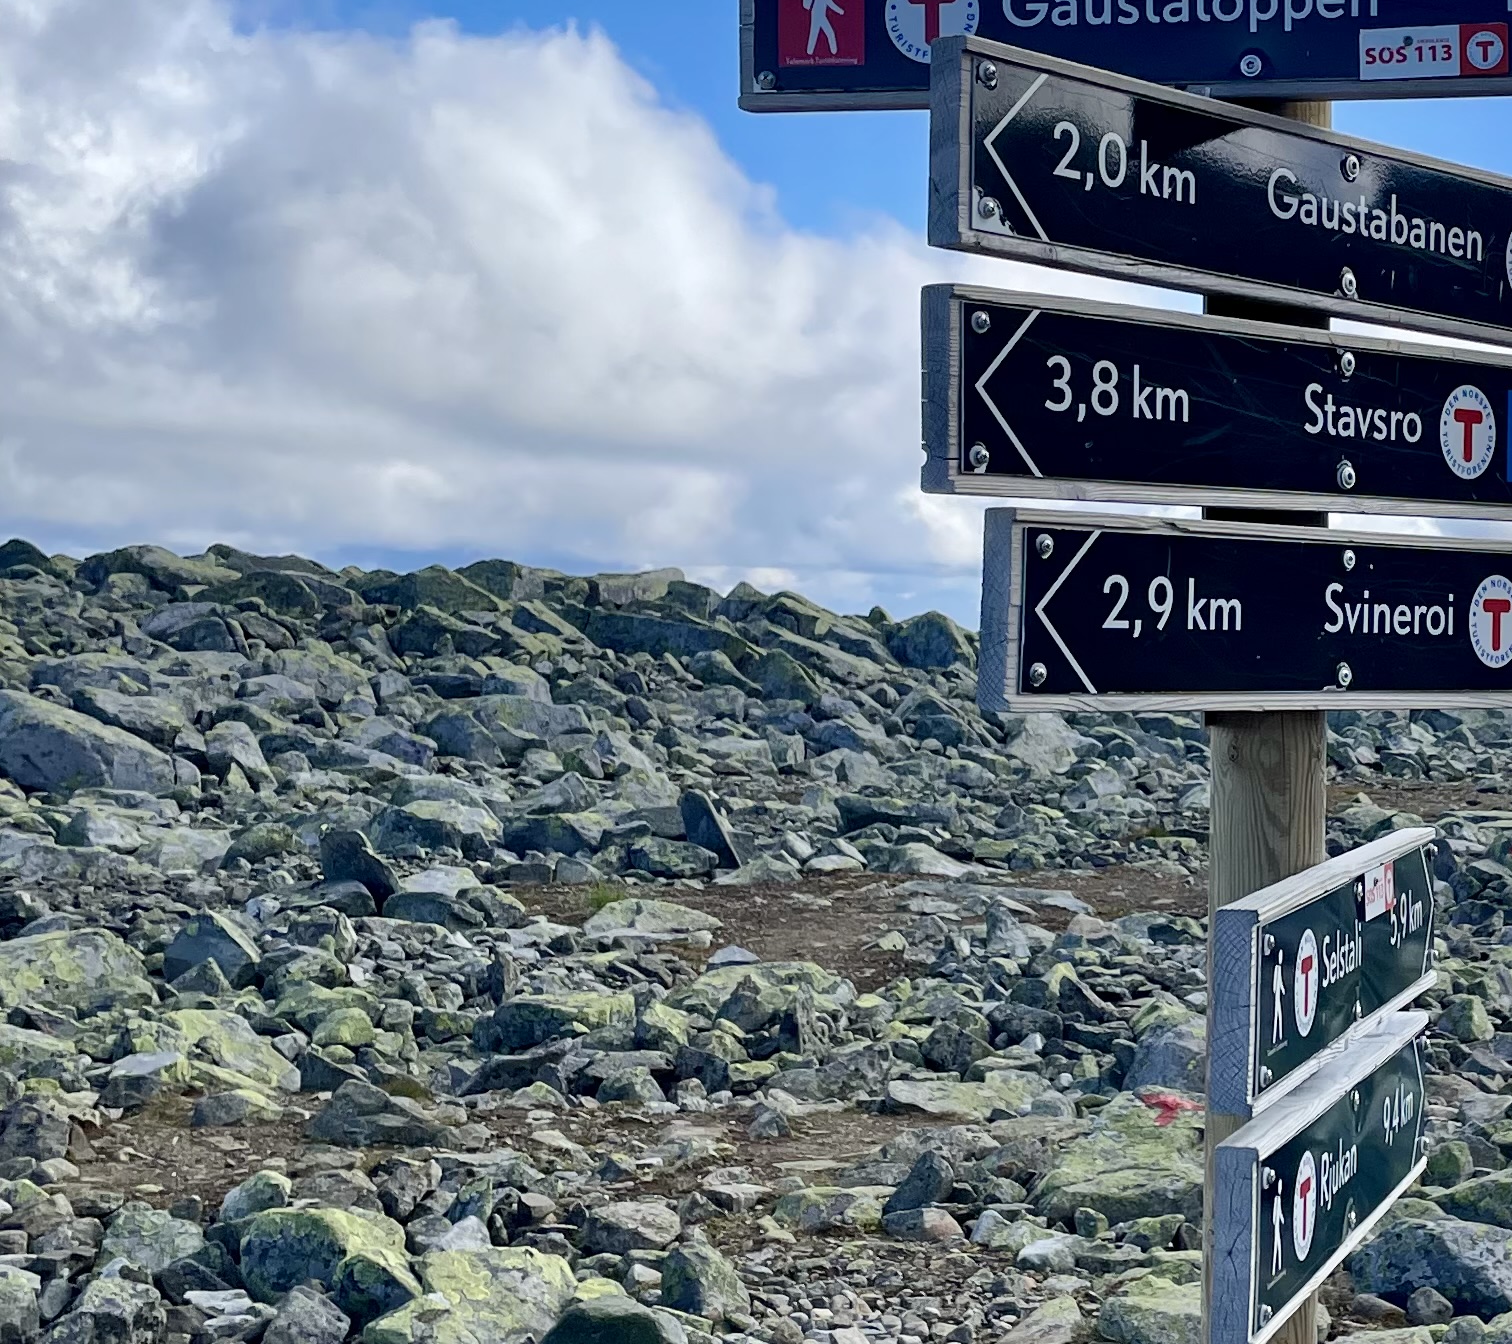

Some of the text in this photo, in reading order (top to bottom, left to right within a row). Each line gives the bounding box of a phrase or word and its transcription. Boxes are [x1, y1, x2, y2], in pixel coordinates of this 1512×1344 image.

[1365, 45, 1408, 65] SOS
[1414, 44, 1453, 63] 113
[1052, 120, 1483, 262] 2,0 km Gaustabanen
[1044, 354, 1422, 443] 3,8 km Stavsro
[1453, 408, 1483, 463] T
[1101, 574, 1454, 638] 2,9 km Svineroi
[1482, 598, 1511, 652] T
[1321, 921, 1363, 988] Selstali
[1390, 892, 1408, 950] 5,9
[1408, 889, 1423, 934] km
[1320, 1138, 1358, 1211] Rjukan
[1383, 1087, 1400, 1147] 9,4
[1400, 1083, 1414, 1128] km
